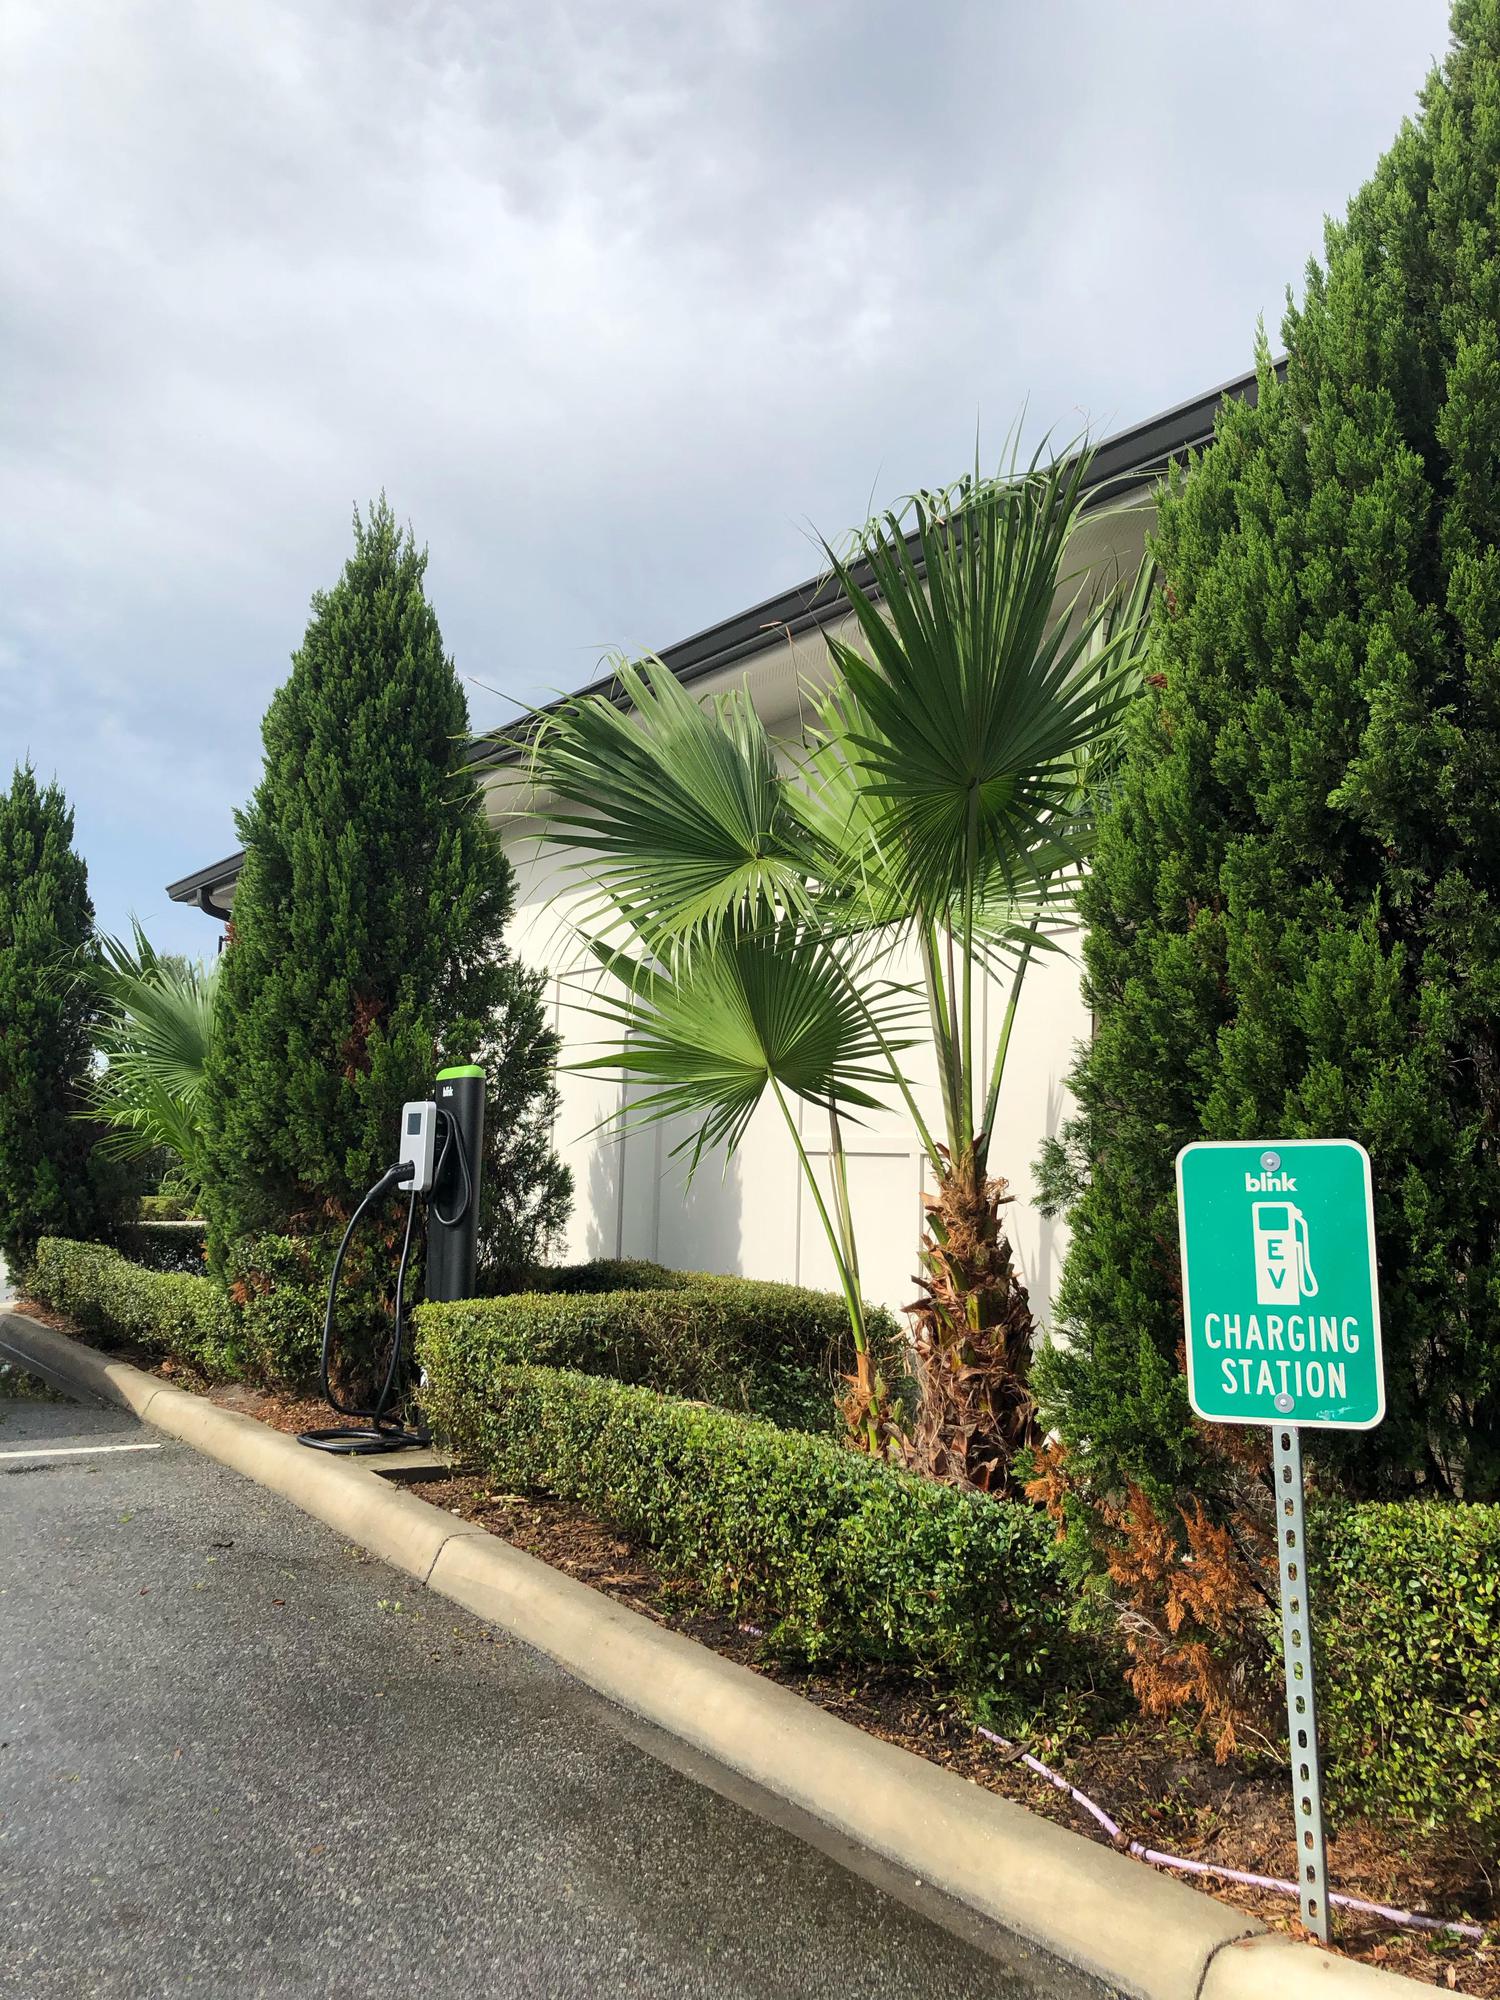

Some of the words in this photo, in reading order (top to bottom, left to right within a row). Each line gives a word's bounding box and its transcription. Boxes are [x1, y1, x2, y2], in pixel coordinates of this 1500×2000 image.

[1245, 1171, 1298, 1193] blink
[1204, 1313, 1360, 1354] CHARGING
[1221, 1358, 1347, 1399] STATION
